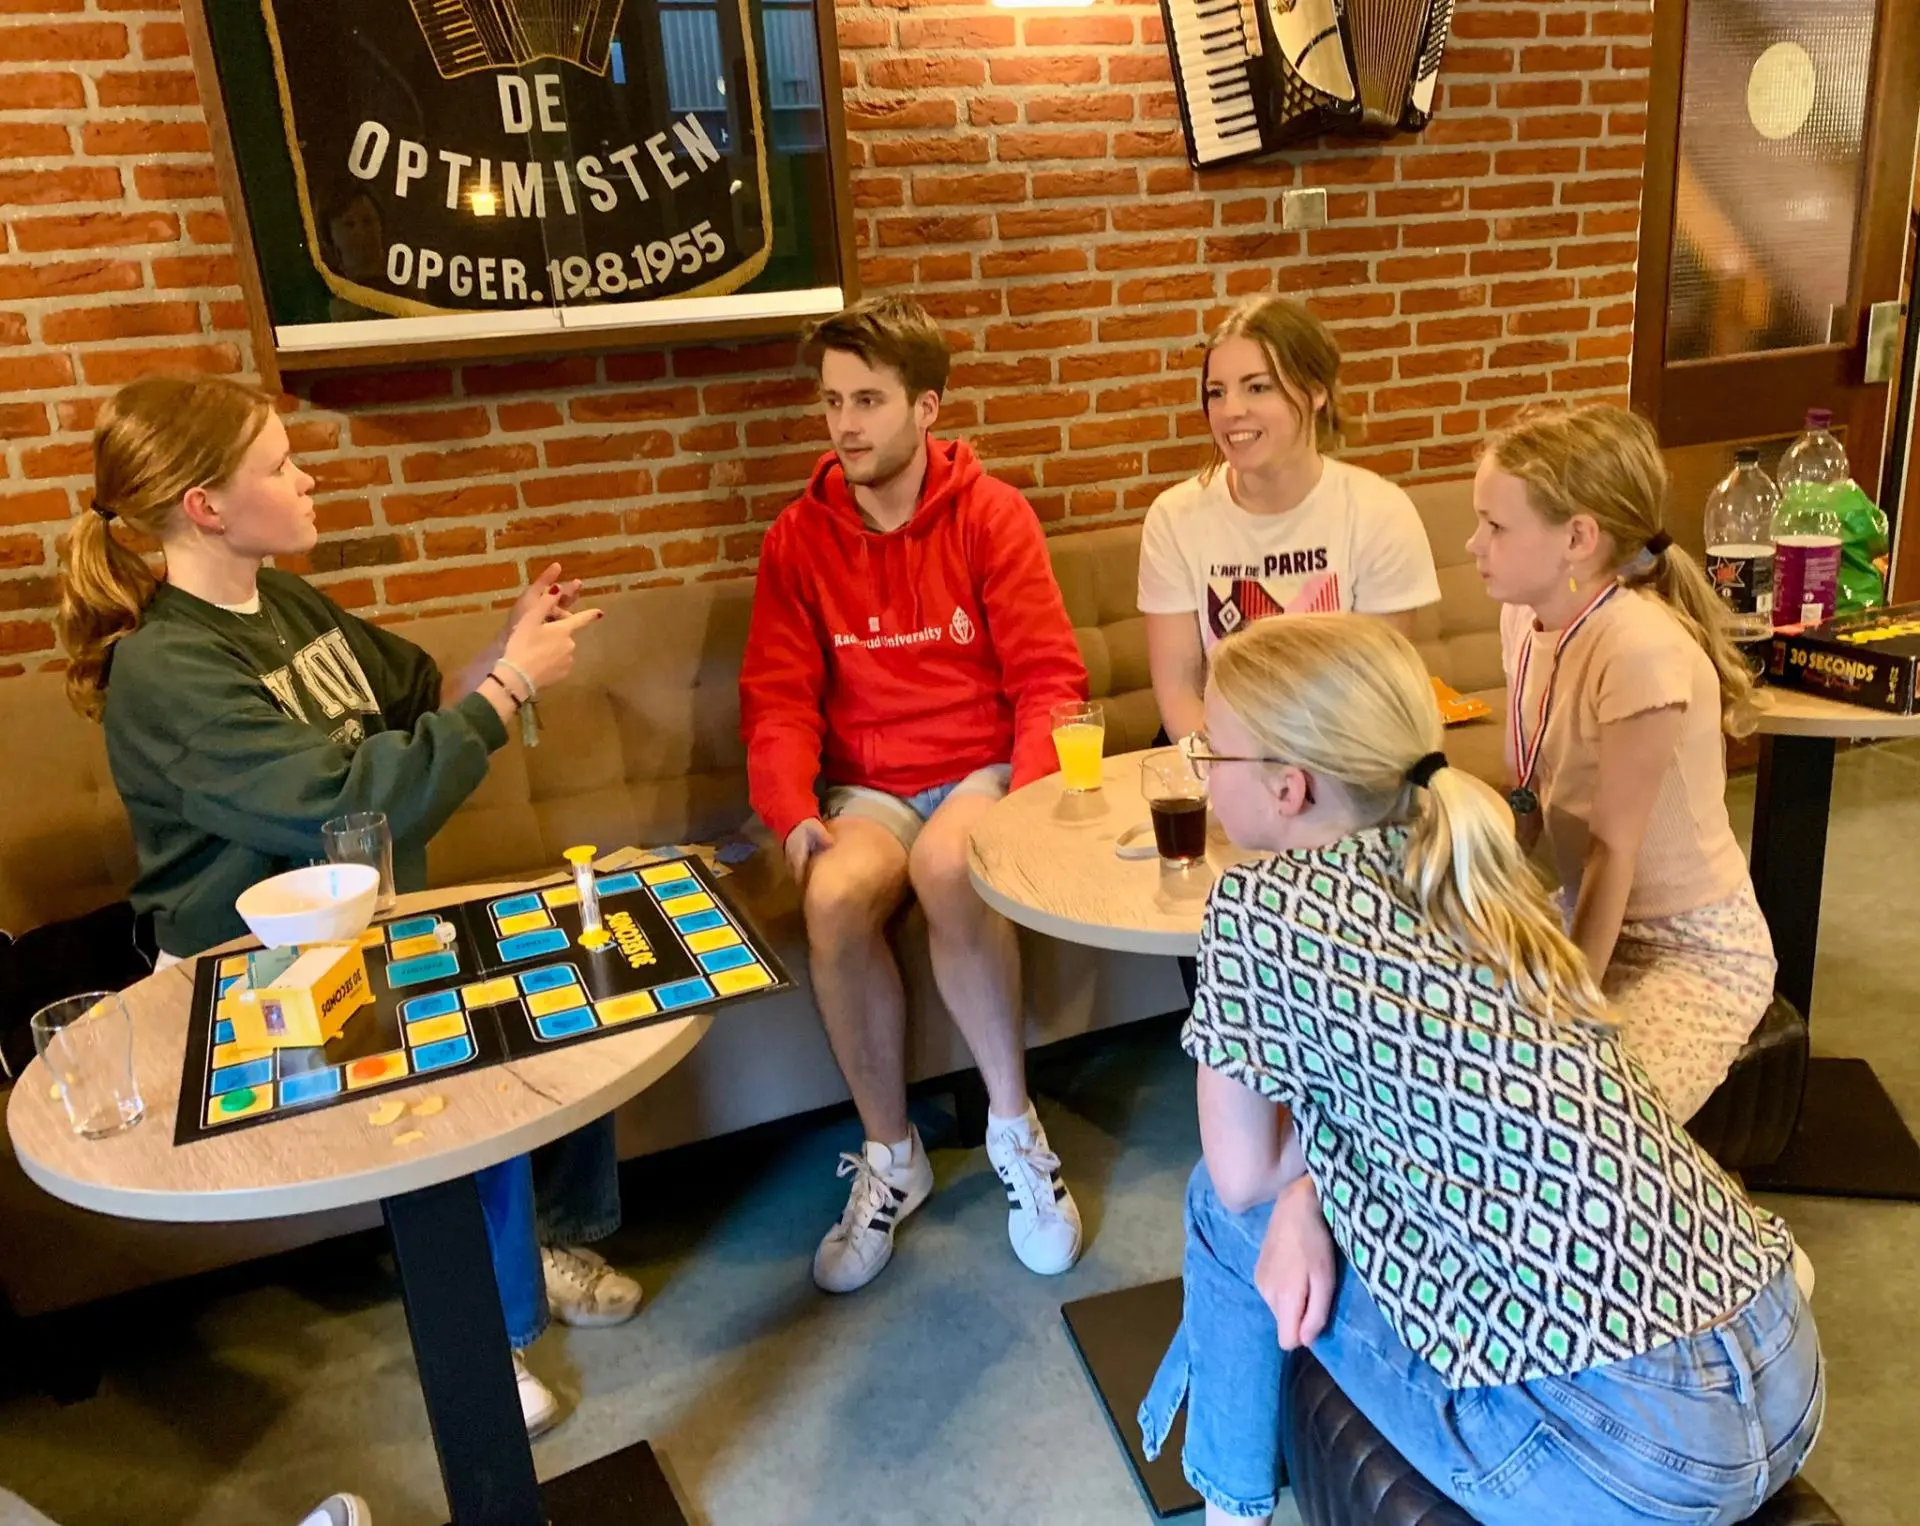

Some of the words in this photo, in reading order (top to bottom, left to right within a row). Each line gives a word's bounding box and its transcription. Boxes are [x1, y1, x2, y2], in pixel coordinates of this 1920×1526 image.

[497, 74, 567, 134] DE
[348, 112, 721, 219] OPTIMISTEN
[1264, 546, 1328, 577] PARIS
[1790, 648, 1806, 666] 30
[1809, 652, 1875, 681] SECONDS
